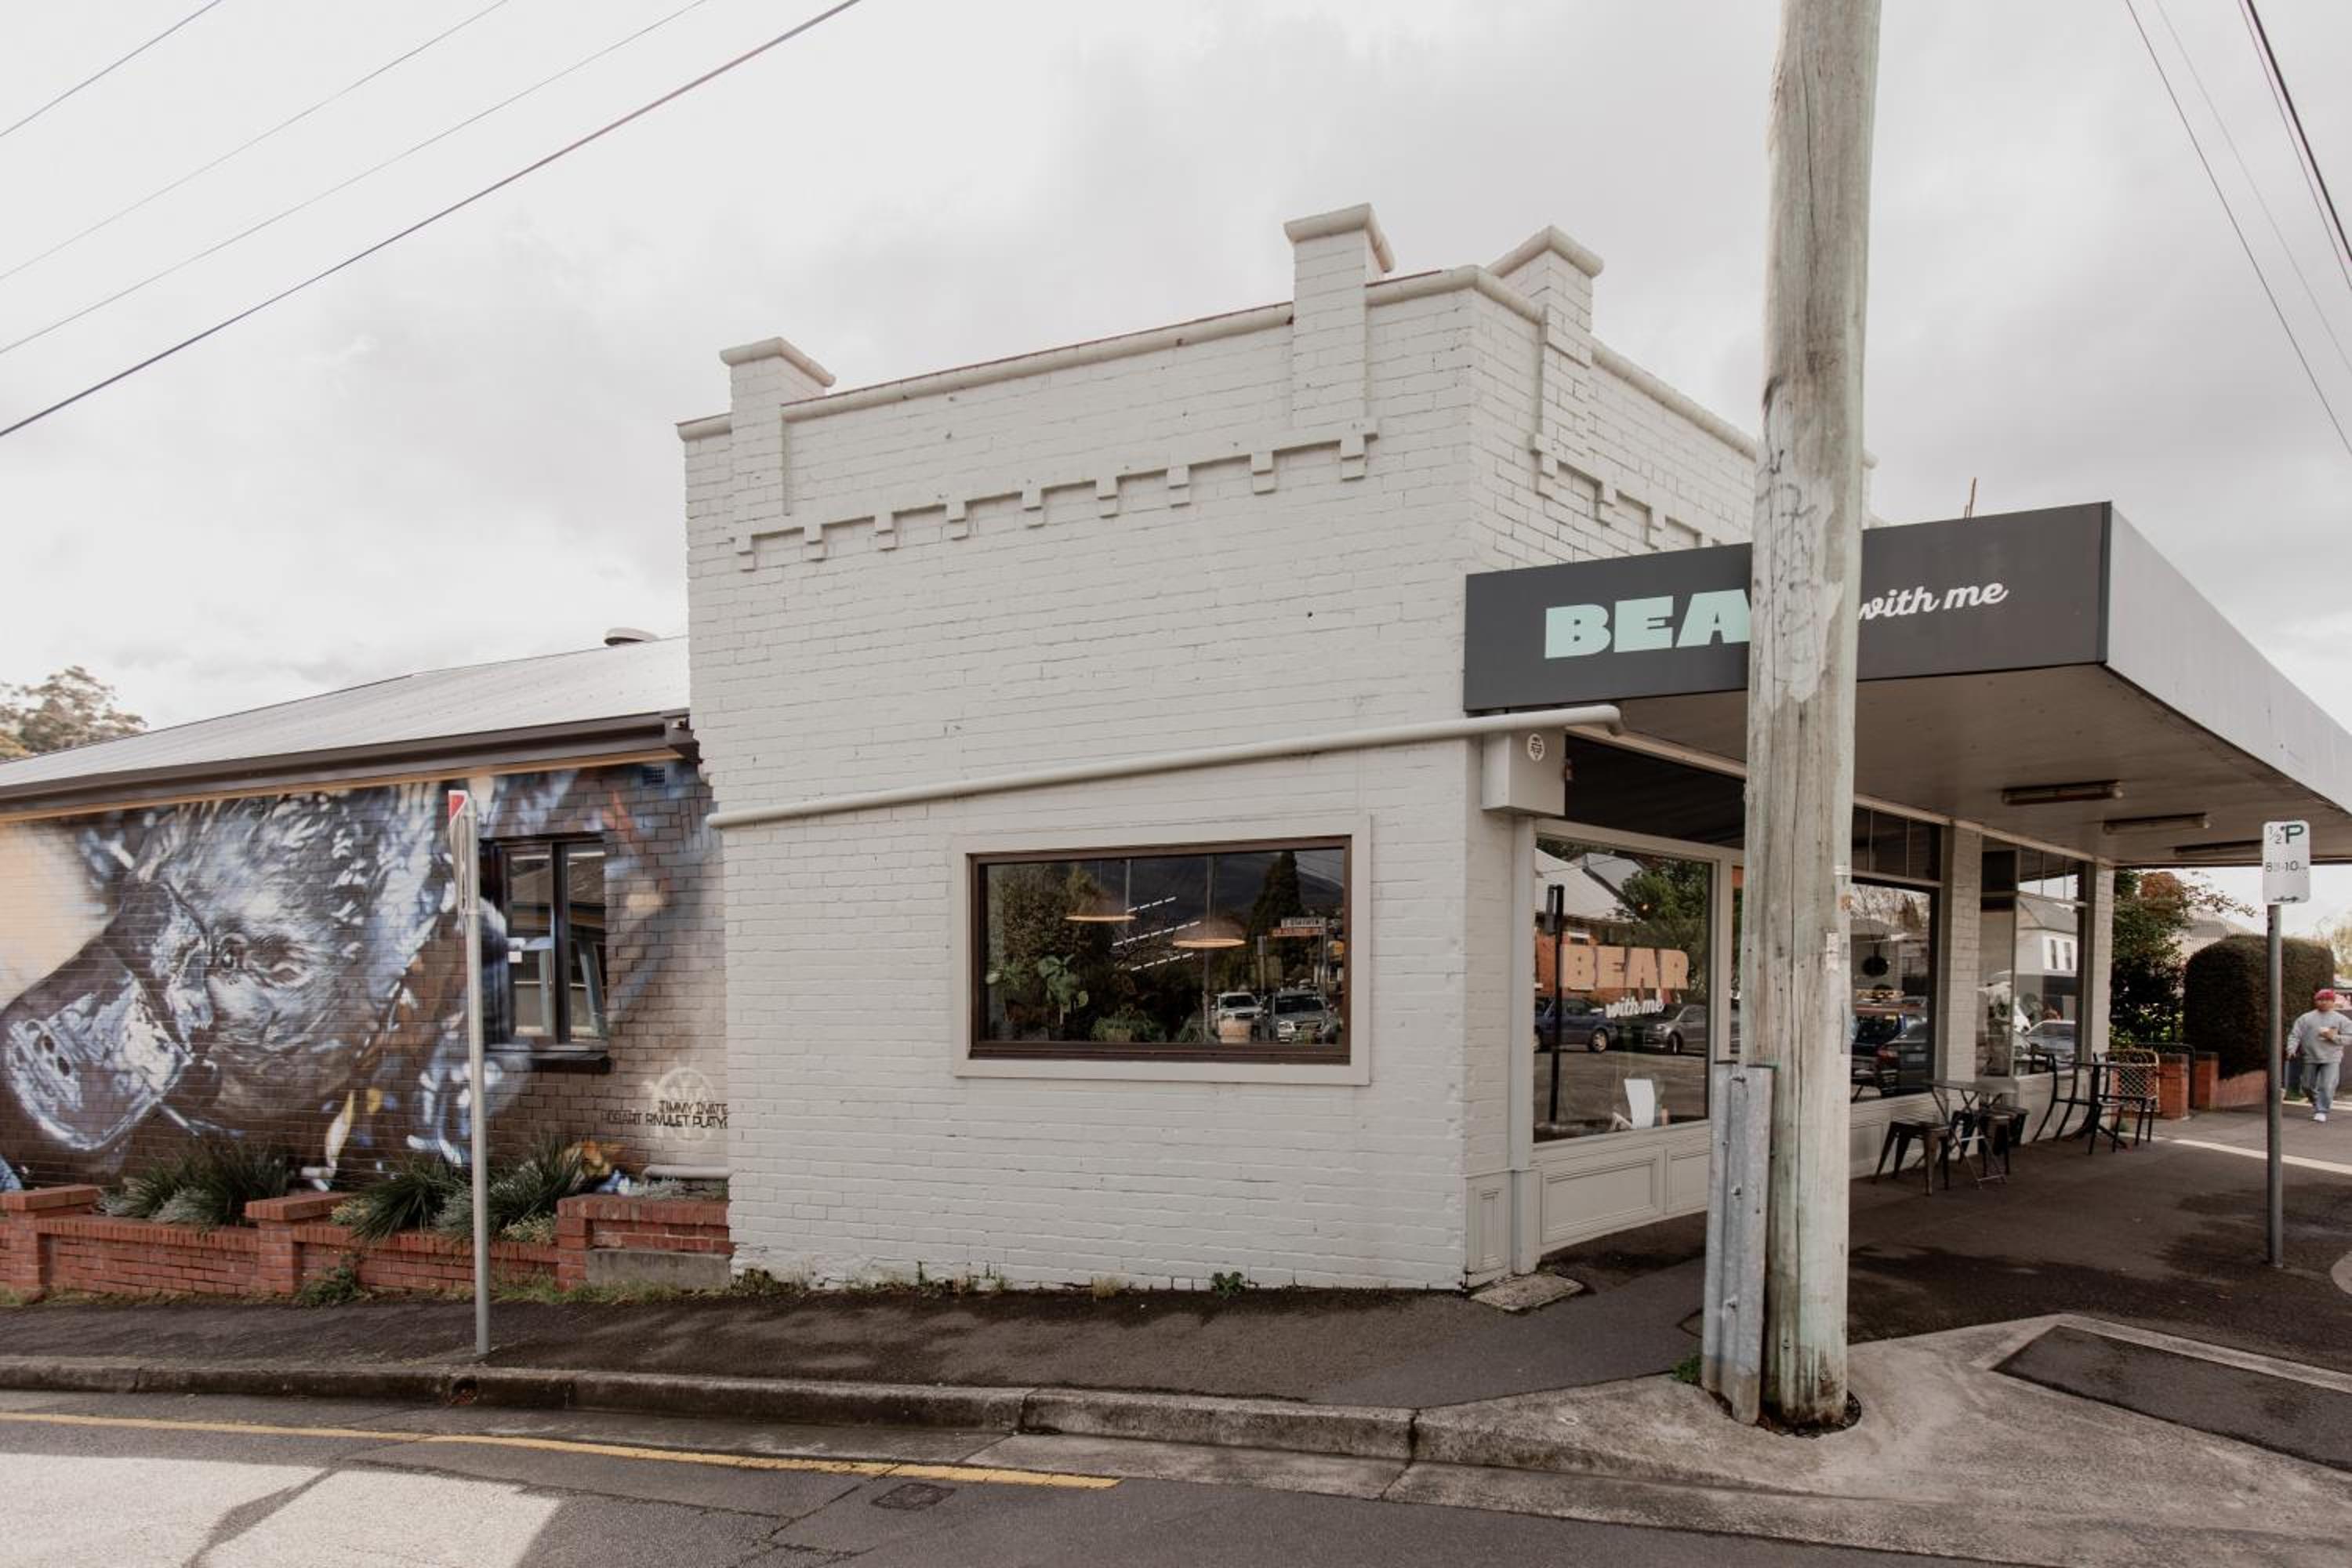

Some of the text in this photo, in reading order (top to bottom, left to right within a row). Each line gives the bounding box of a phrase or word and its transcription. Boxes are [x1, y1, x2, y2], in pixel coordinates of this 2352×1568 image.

[1544, 589, 1751, 659] BEA
[1943, 581, 2009, 611] me
[1561, 943, 1690, 989] BEAR
[1605, 996, 1664, 1018] with me
